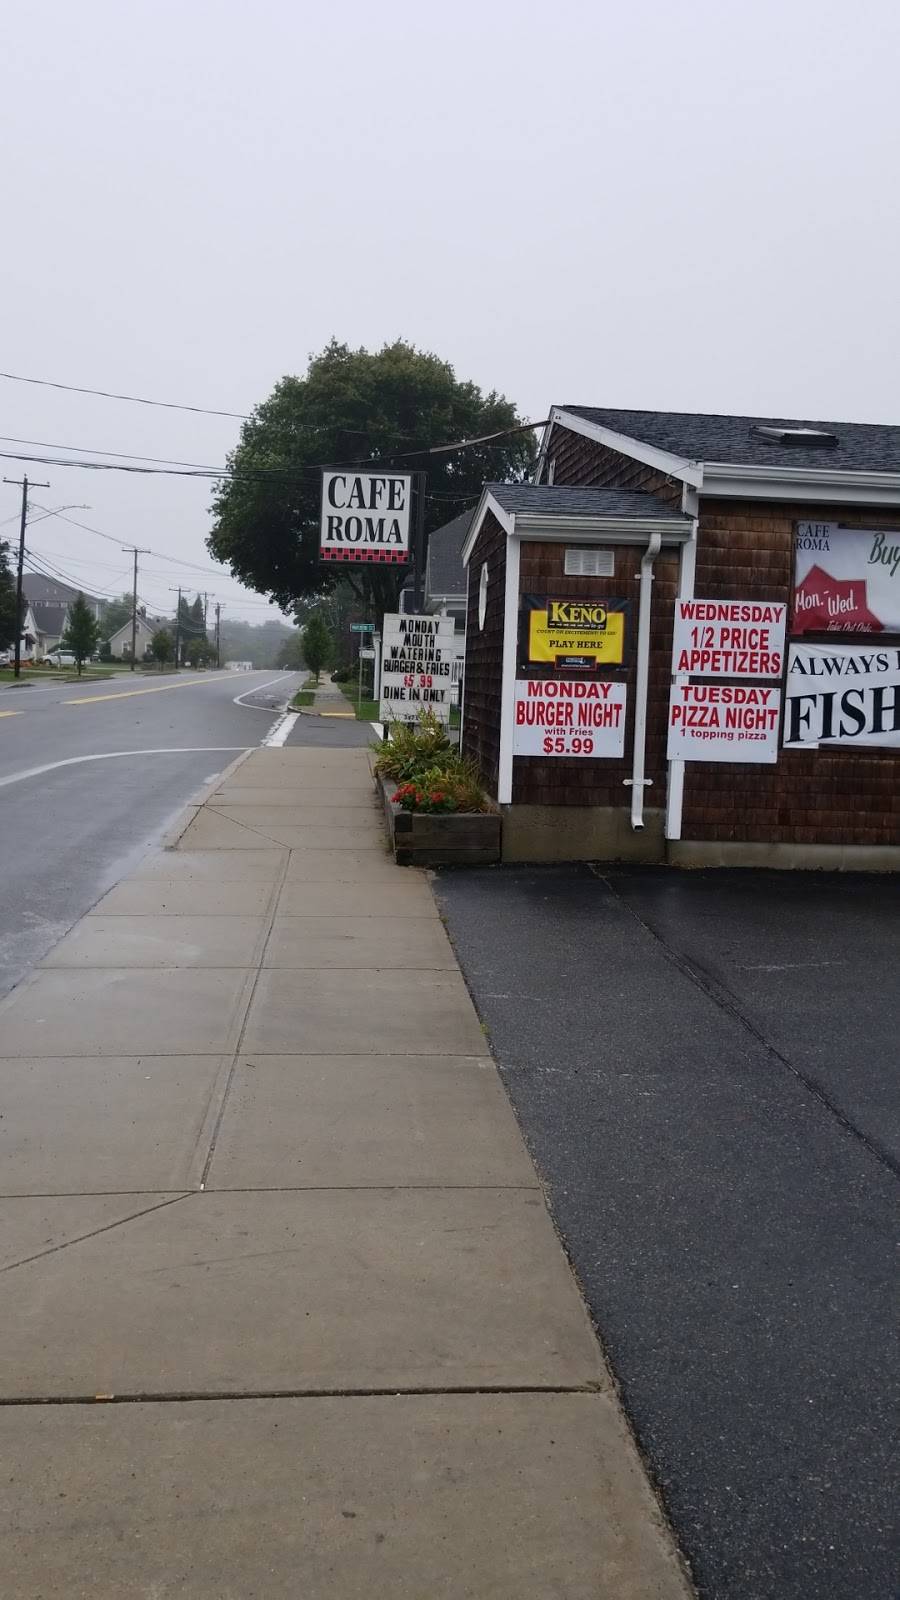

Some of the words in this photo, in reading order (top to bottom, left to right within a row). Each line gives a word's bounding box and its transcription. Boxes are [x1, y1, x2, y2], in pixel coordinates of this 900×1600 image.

[328, 476, 405, 511] CAFE
[327, 516, 403, 543] ROMA
[796, 524, 830, 537] CAFE
[796, 538, 830, 551] ROMA
[552, 602, 606, 623] KENO
[681, 604, 783, 623] WEDNESDAY
[399, 620, 440, 634] MONDAY
[404, 634, 435, 648] MOUTH
[550, 640, 574, 648] PLAY
[691, 627, 714, 648] 1/2
[720, 628, 769, 650] PRICE
[391, 646, 441, 661] WATERING
[678, 650, 780, 673] APPETIZERS
[790, 654, 889, 676] ALWAYS
[384, 687, 405, 700] DINE
[409, 689, 420, 700] IN
[423, 689, 445, 702] ONLY
[528, 682, 612, 698] MONDAY
[681, 687, 771, 705] TUESDAY
[516, 701, 573, 726] BURGER
[578, 703, 622, 728] NIGHT
[671, 705, 719, 727] PIZZA
[726, 708, 778, 730] NIGHT
[785, 685, 900, 743] FISH
[569, 728, 593, 736] Fries
[680, 729, 686, 737] 1
[691, 731, 734, 740] topping
[738, 731, 767, 740] pizza
[543, 737, 594, 754] $5.99
